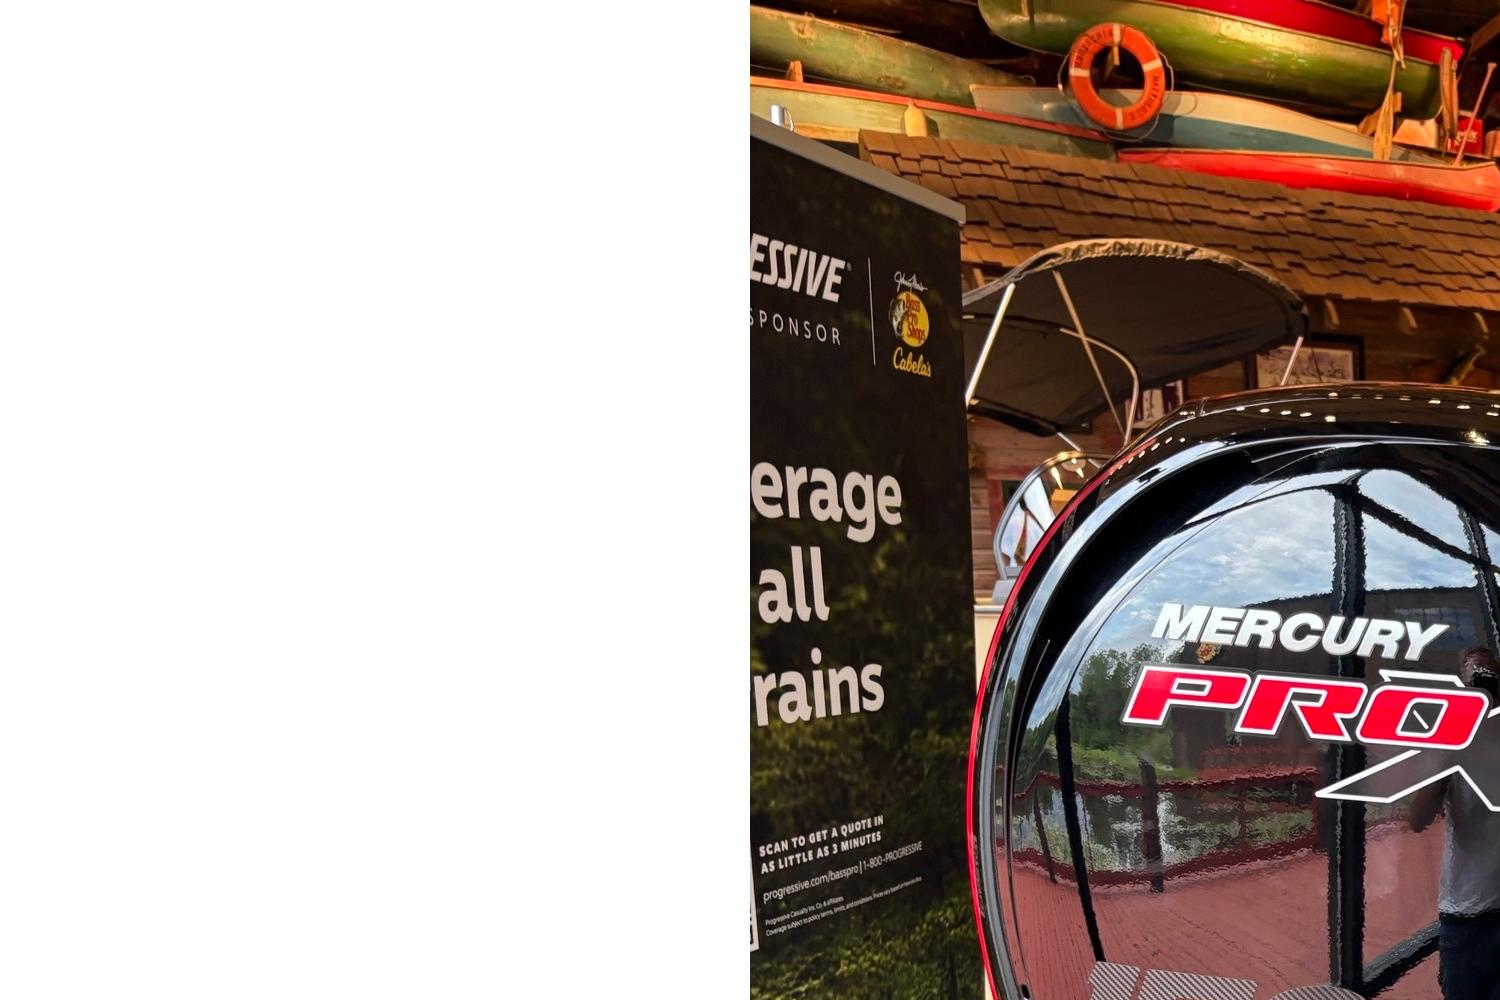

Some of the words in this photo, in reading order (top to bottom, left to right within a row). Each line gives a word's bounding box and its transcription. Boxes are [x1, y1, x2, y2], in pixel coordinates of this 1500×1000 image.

[906, 293, 921, 313] Bass
[893, 346, 932, 377] Cabela's
[751, 462, 902, 543] erage
[758, 546, 830, 624] all
[1150, 602, 1451, 662] MERCURY
[753, 647, 885, 727] rains
[1120, 663, 1491, 751] PRO
[759, 839, 789, 857] SCAN
[791, 835, 806, 849] TO
[808, 829, 828, 844] GET
[831, 827, 838, 839] A
[840, 817, 872, 837] QUOTE
[874, 813, 884, 827] IN
[761, 860, 775, 875] AS
[778, 849, 814, 870] LITTLE
[816, 845, 830, 859] AS
[832, 843, 838, 855] 3
[840, 830, 882, 852] MINUTES
[763, 865, 859, 905] progressive.com/basspro
